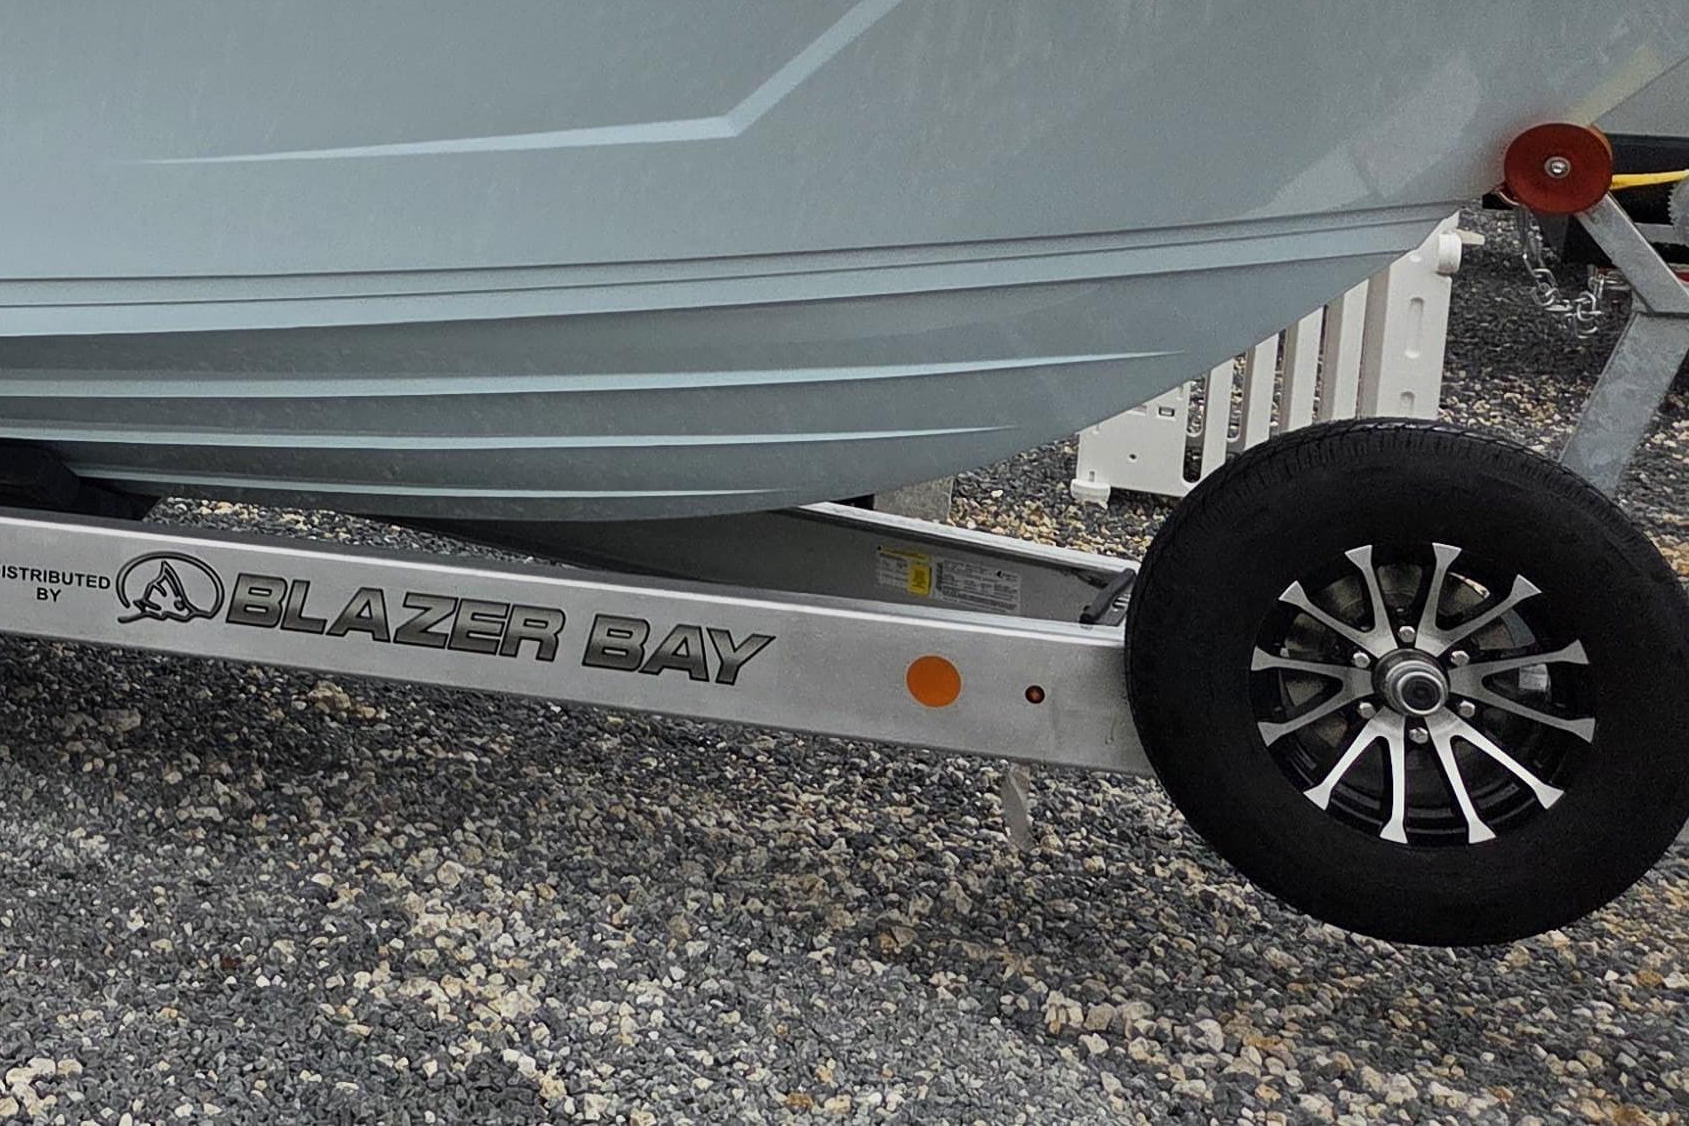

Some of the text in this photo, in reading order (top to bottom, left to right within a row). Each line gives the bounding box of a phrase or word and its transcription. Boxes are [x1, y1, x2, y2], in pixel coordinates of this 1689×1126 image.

[36, 588, 62, 603] BY
[225, 572, 777, 687] BLAZER BAY
